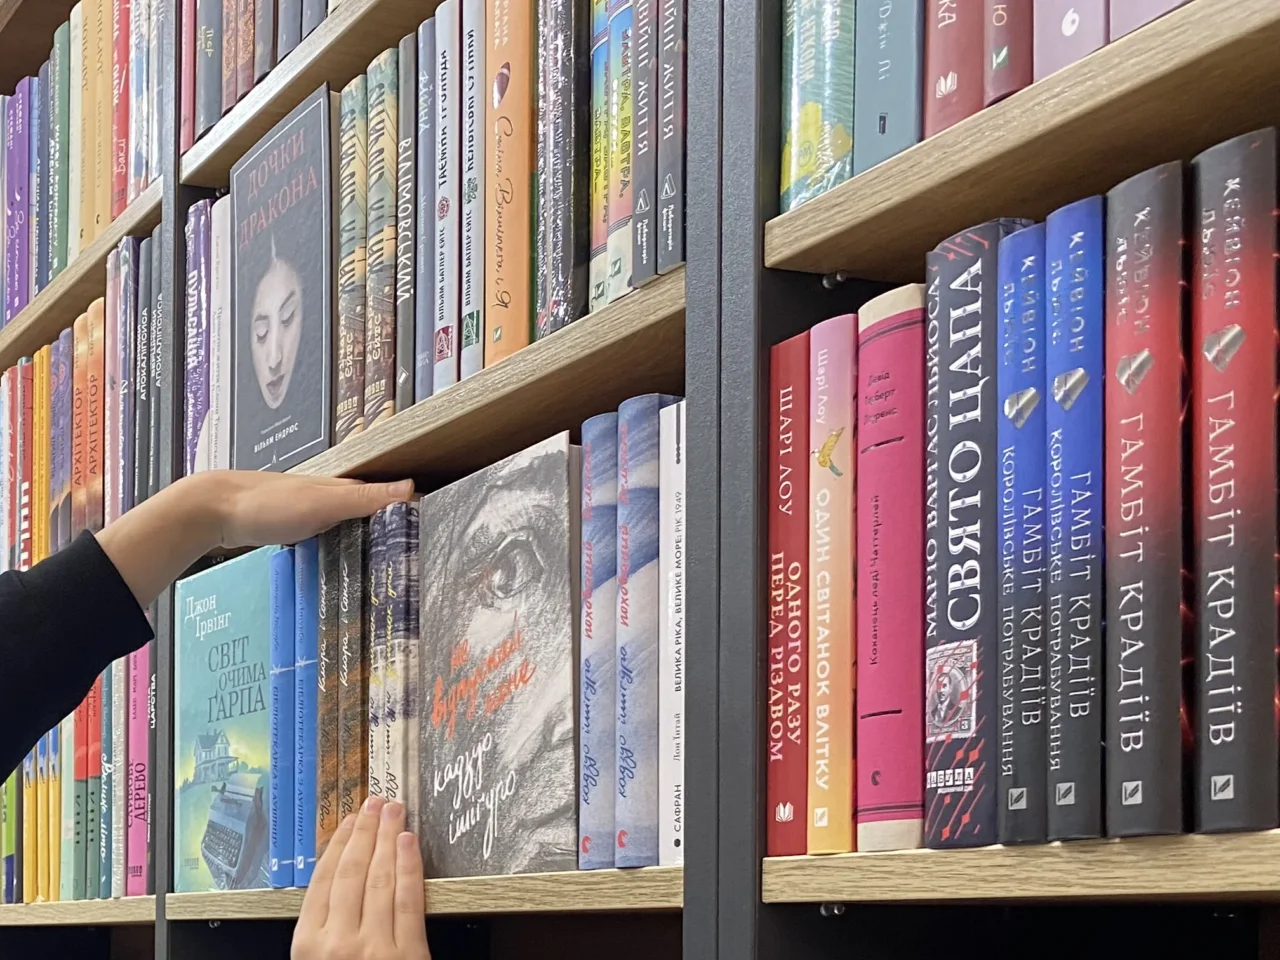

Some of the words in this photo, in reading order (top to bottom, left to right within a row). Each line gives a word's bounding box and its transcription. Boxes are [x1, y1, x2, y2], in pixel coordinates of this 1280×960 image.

[246, 127, 307, 201] ДОЧКИ
[238, 166, 319, 249] ДРАКОНА
[396, 136, 414, 306] ВІЛІМОВСЬКИЙ
[816, 349, 828, 393] Шарі
[947, 257, 989, 430] ЦАПА
[254, 432, 274, 454] ВІЛЬЯМ
[275, 421, 299, 443] ЕНДРЮС
[779, 385, 793, 456] ШАРІ
[815, 393, 827, 424] Лоу
[779, 464, 793, 516] ЛОУ
[1118, 412, 1150, 563] ГАМБІТ
[1206, 389, 1242, 548] ГАМБІТ
[815, 487, 830, 562] ОДИН
[946, 440, 982, 633] СВЯТО
[1001, 444, 1016, 596] КОРОЛІВСЬКЕ
[1021, 487, 1045, 594] ГАМБІТ
[1067, 471, 1096, 580] ГАМБІТ
[184, 595, 217, 623] Джон
[196, 610, 231, 641] Ірвінг
[769, 551, 783, 637] ПЕРЕД
[787, 560, 801, 674] ОДНОГО
[815, 570, 830, 698] СВІТАНОК
[208, 636, 249, 672] СВІТ
[218, 661, 267, 691] ОЧИМА
[317, 639, 328, 692] Клара
[340, 632, 351, 688] Клара
[1001, 605, 1015, 777] ПОГРАБУВАННЯ
[1020, 605, 1046, 727] КРАДІЇВ
[1067, 593, 1097, 719] КРАДІЇВ
[1117, 581, 1150, 754] КРАДІЇВ
[1205, 564, 1242, 746] КРАДІЇВ
[769, 645, 783, 762] РІЗДВОМ
[786, 683, 801, 746] РАЗУ
[434, 732, 492, 809] кадзуо
[815, 704, 829, 790] ВЛІТКУ
[134, 762, 147, 822] ДЕРЕВО
